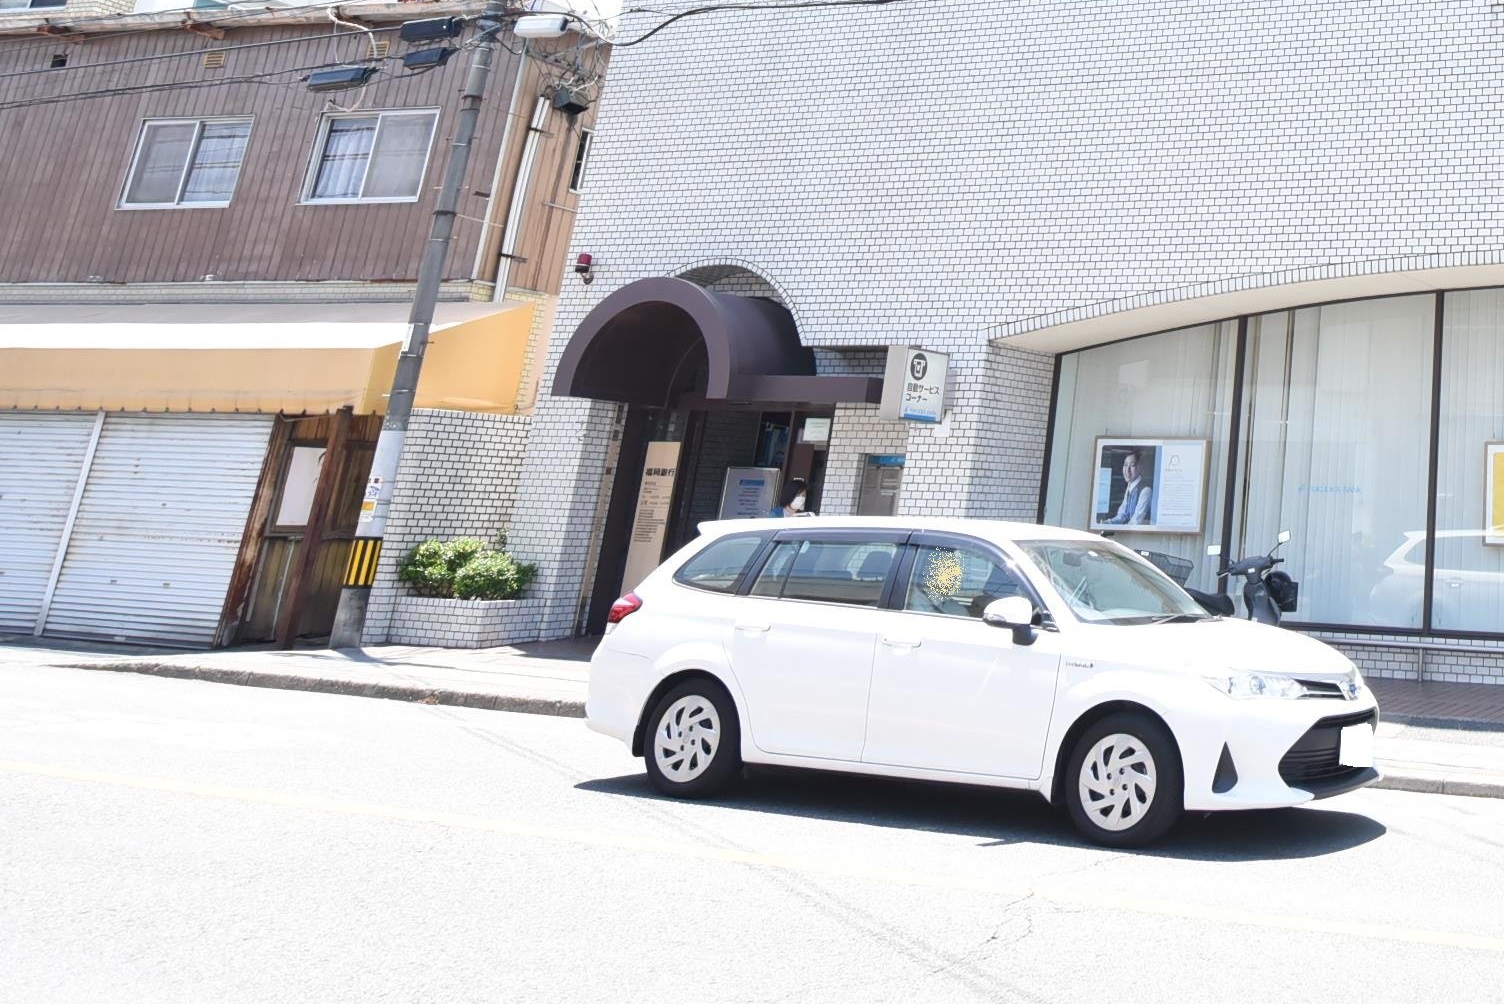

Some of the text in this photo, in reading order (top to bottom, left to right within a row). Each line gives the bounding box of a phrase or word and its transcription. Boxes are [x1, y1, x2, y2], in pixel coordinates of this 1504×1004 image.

[907, 383, 940, 395] 自動サービス
[905, 393, 928, 403] コーナー
